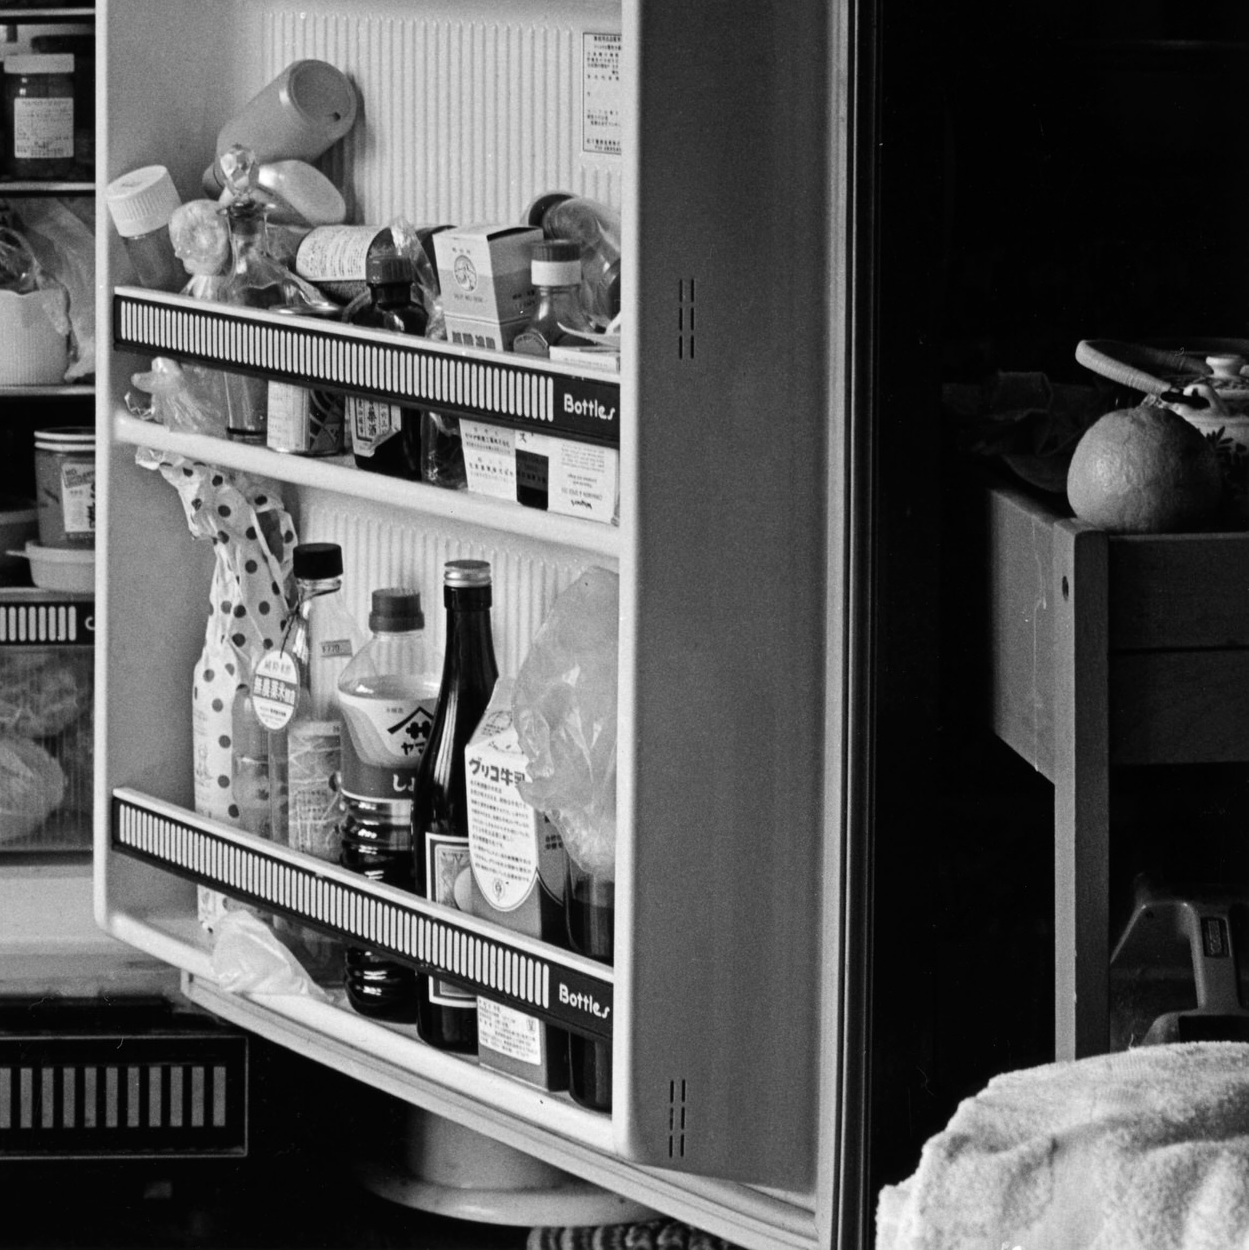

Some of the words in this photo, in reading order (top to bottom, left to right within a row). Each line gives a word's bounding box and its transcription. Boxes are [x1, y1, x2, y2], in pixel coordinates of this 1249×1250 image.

[563, 392, 616, 421] Bottles
[400, 740, 427, 756] ヤマ
[392, 773, 415, 792] しょ
[559, 983, 610, 1018] Bottles
